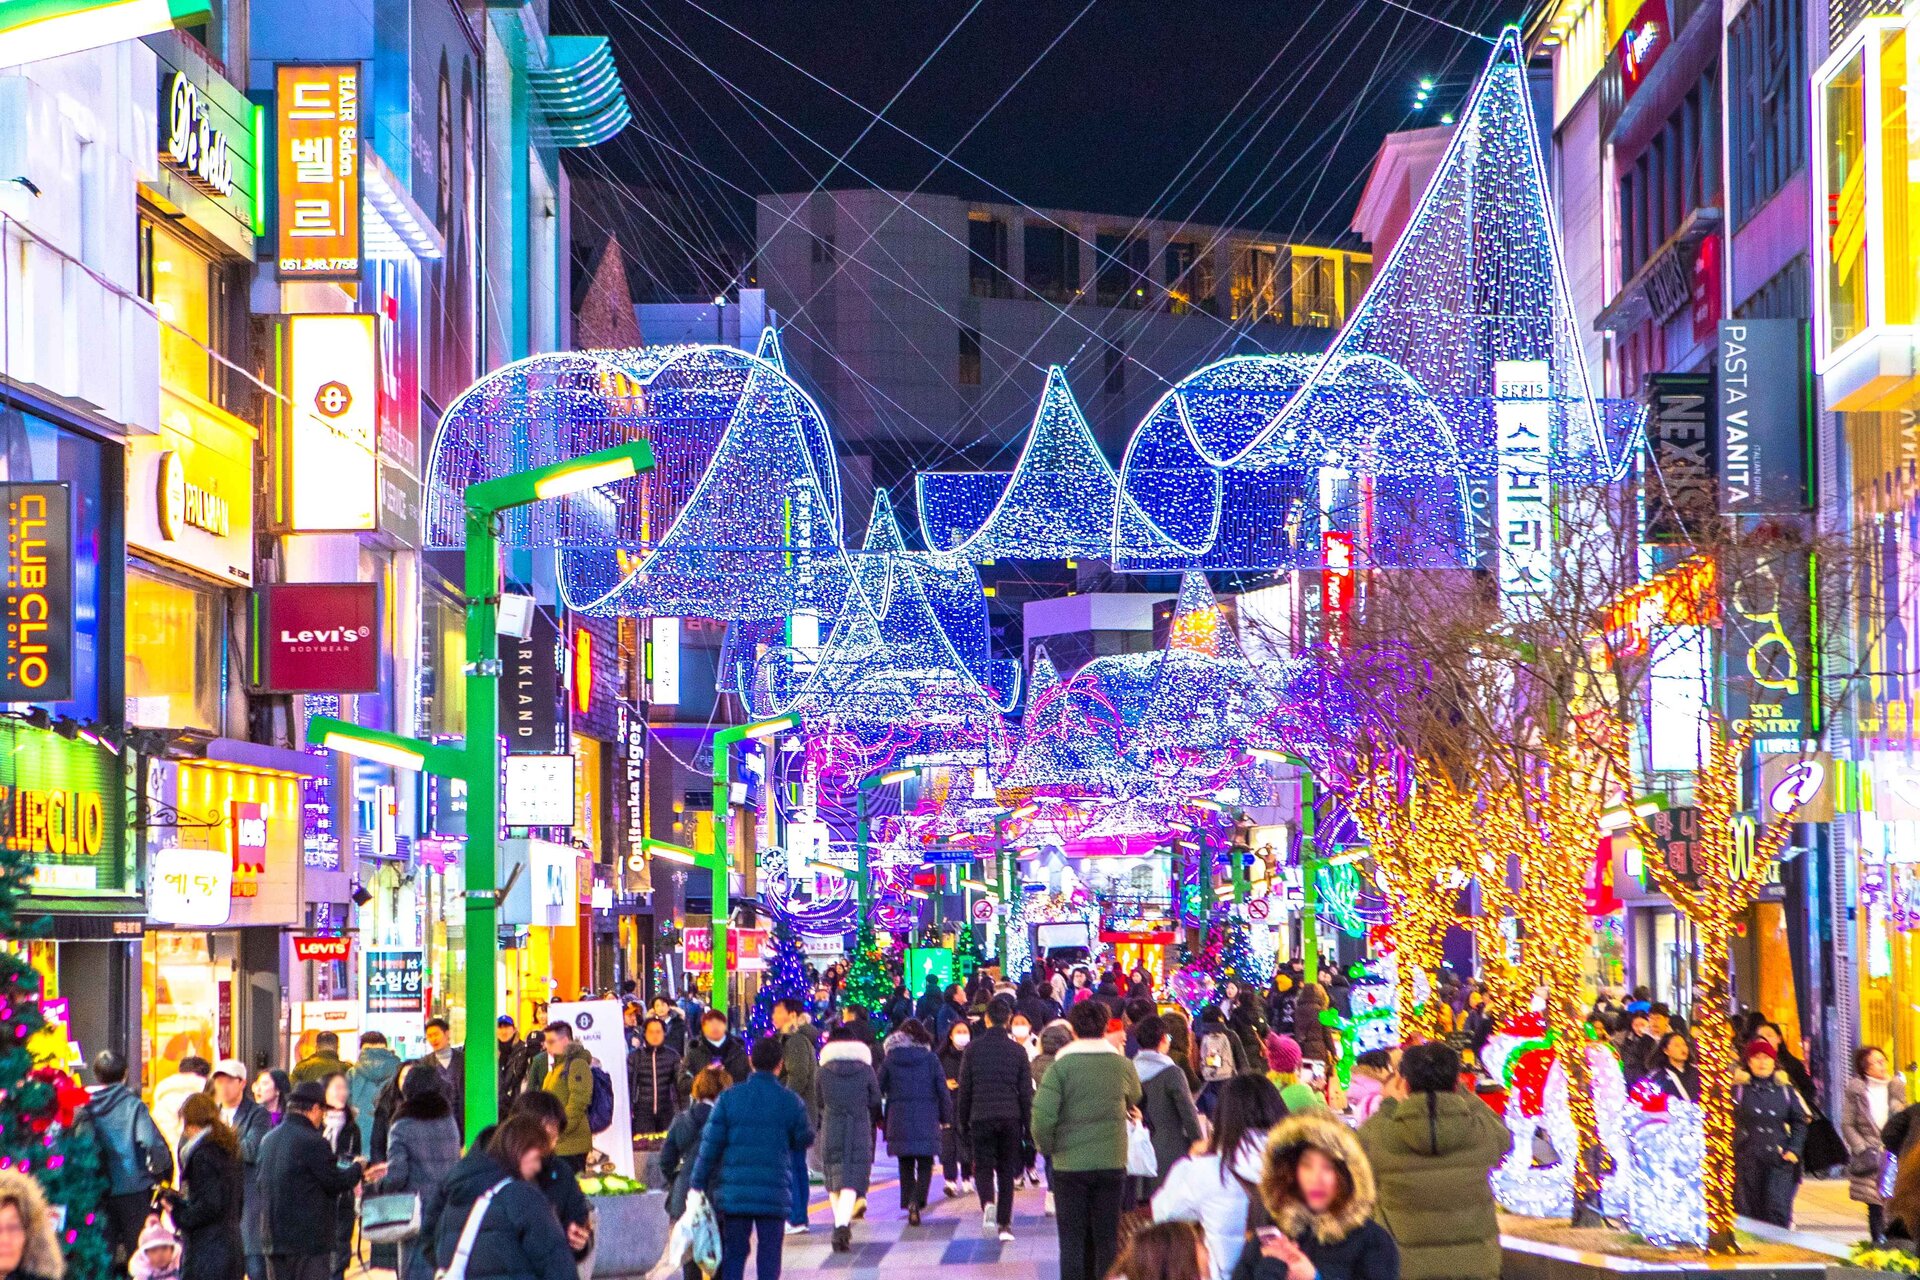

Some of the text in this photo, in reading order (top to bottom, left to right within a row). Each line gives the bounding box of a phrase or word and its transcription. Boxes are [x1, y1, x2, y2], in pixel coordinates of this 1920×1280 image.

[338, 75, 356, 176] HAIR Salon
[1724, 325, 1749, 504] PASTA VANITA
[290, 645, 349, 653] BODYWEAR
[369, 970, 421, 993] 수험생
